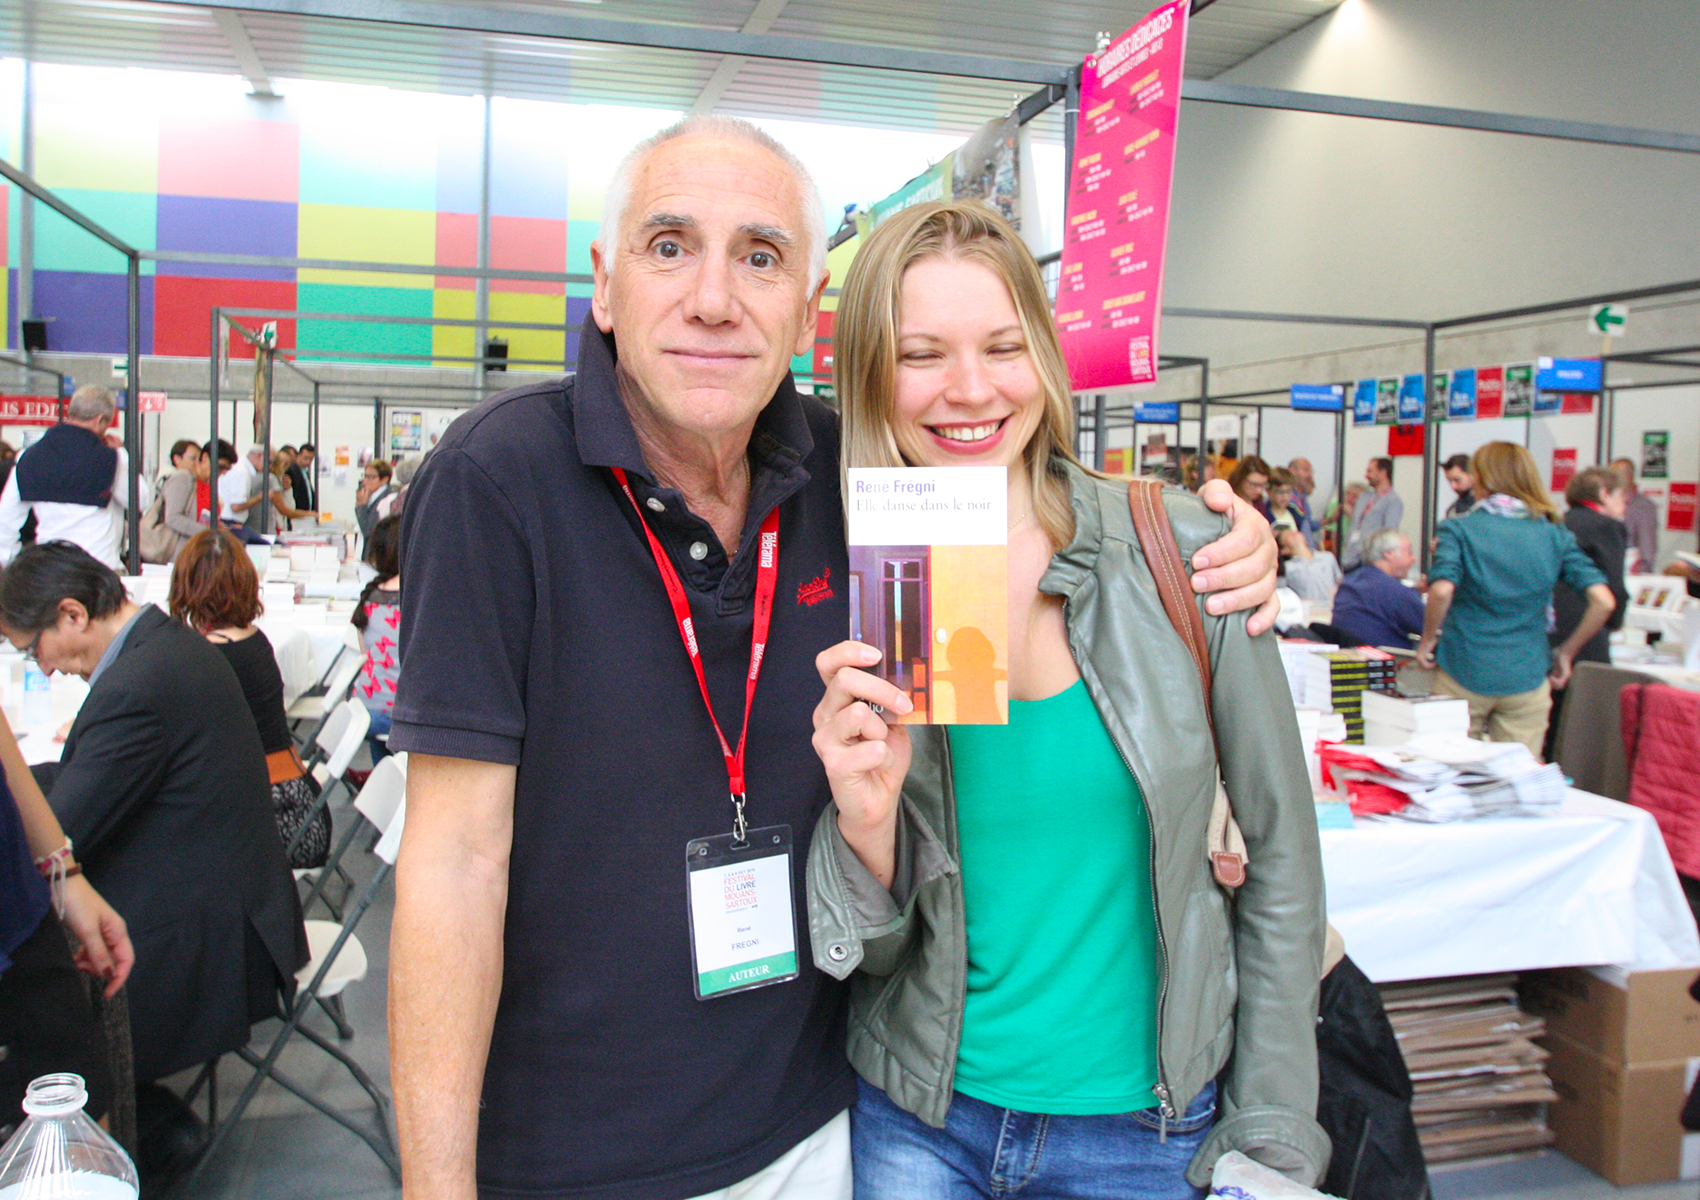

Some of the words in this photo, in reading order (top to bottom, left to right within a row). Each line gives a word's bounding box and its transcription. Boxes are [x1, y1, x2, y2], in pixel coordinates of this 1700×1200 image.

[856, 479, 890, 493] René
[894, 479, 935, 496] Frégni
[857, 498, 878, 511] Elle
[882, 498, 917, 511] danse
[920, 498, 949, 511] dans
[953, 498, 963, 511] le
[967, 498, 992, 511] noir
[760, 531, 777, 568] Télérama
[682, 617, 700, 659] Télérama
[724, 873, 755, 885] FESTIVAL
[724, 885, 735, 894] DU
[736, 880, 757, 891] LIVRE
[725, 896, 758, 910] SARTOUX
[728, 964, 770, 983] AUTEUR
